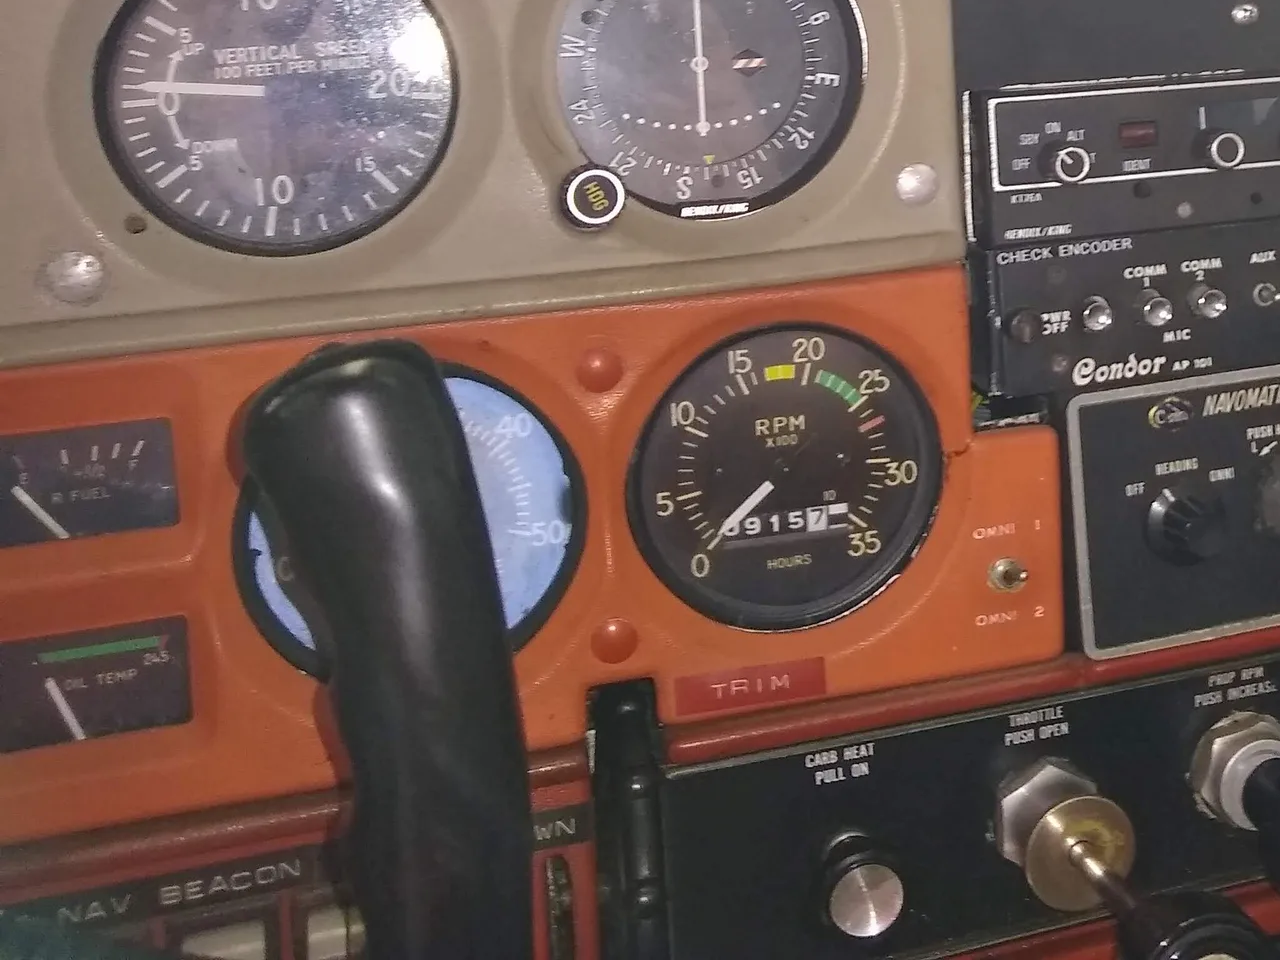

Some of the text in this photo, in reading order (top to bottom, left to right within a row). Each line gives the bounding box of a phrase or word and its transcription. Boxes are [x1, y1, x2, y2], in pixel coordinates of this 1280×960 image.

[808, 10, 831, 26] 6
[178, 27, 193, 43] 5
[558, 33, 588, 60] W
[213, 43, 302, 64] VERTICAL
[245, 62, 283, 78] FEET
[286, 59, 317, 74] PER
[813, 72, 841, 88] E
[367, 68, 411, 100] 20
[568, 98, 598, 125] 24
[787, 125, 816, 152] 12
[1044, 121, 1062, 135] ON
[1066, 129, 1086, 142] ALT
[188, 155, 204, 172] 5
[355, 150, 377, 173] 15
[608, 151, 638, 178] 21
[1011, 157, 1032, 171] OFF
[1122, 158, 1152, 172] IDENT
[675, 175, 695, 200] S
[736, 168, 765, 191] 15
[254, 175, 296, 208] 10
[583, 180, 609, 212] HDG
[996, 237, 1134, 266] CHECK ENCODER
[1249, 249, 1277, 264] AUX
[1122, 264, 1168, 279] COMM
[1179, 257, 1224, 273] COMM
[1195, 270, 1205, 281] 2
[1142, 276, 1151, 288] 1
[1039, 310, 1072, 324] PWR
[1041, 322, 1070, 336] OFF
[1162, 328, 1193, 343] MIC
[728, 348, 753, 375] 15
[791, 336, 827, 364] 20
[857, 368, 892, 395] 25
[1071, 352, 1167, 388] Condor
[1171, 359, 1192, 373] AP
[495, 412, 532, 438] 40
[670, 400, 696, 428] 10
[754, 414, 806, 437] RPM
[1246, 425, 1274, 441] PUSH
[1250, 441, 1259, 454] L
[883, 459, 918, 488] 30
[1154, 457, 1200, 477] HEADING
[1124, 481, 1146, 498] OFF
[655, 491, 675, 518] 5
[530, 519, 567, 547] 50
[972, 522, 1016, 540] OMNI
[847, 529, 883, 558] 35
[690, 553, 711, 578] 0
[766, 553, 813, 570] HOURS
[974, 605, 1045, 626] OMNI 2
[96, 668, 139, 684] TEMP
[709, 674, 790, 700] TRIM
[1193, 690, 1223, 708] PUSH
[1008, 705, 1065, 728] THROTTLE
[1004, 721, 1070, 747] PUSH OPEN
[804, 742, 876, 769] CARB HEAT
[814, 762, 870, 786] PULL ON
[56, 857, 301, 924] NAV BEACON
